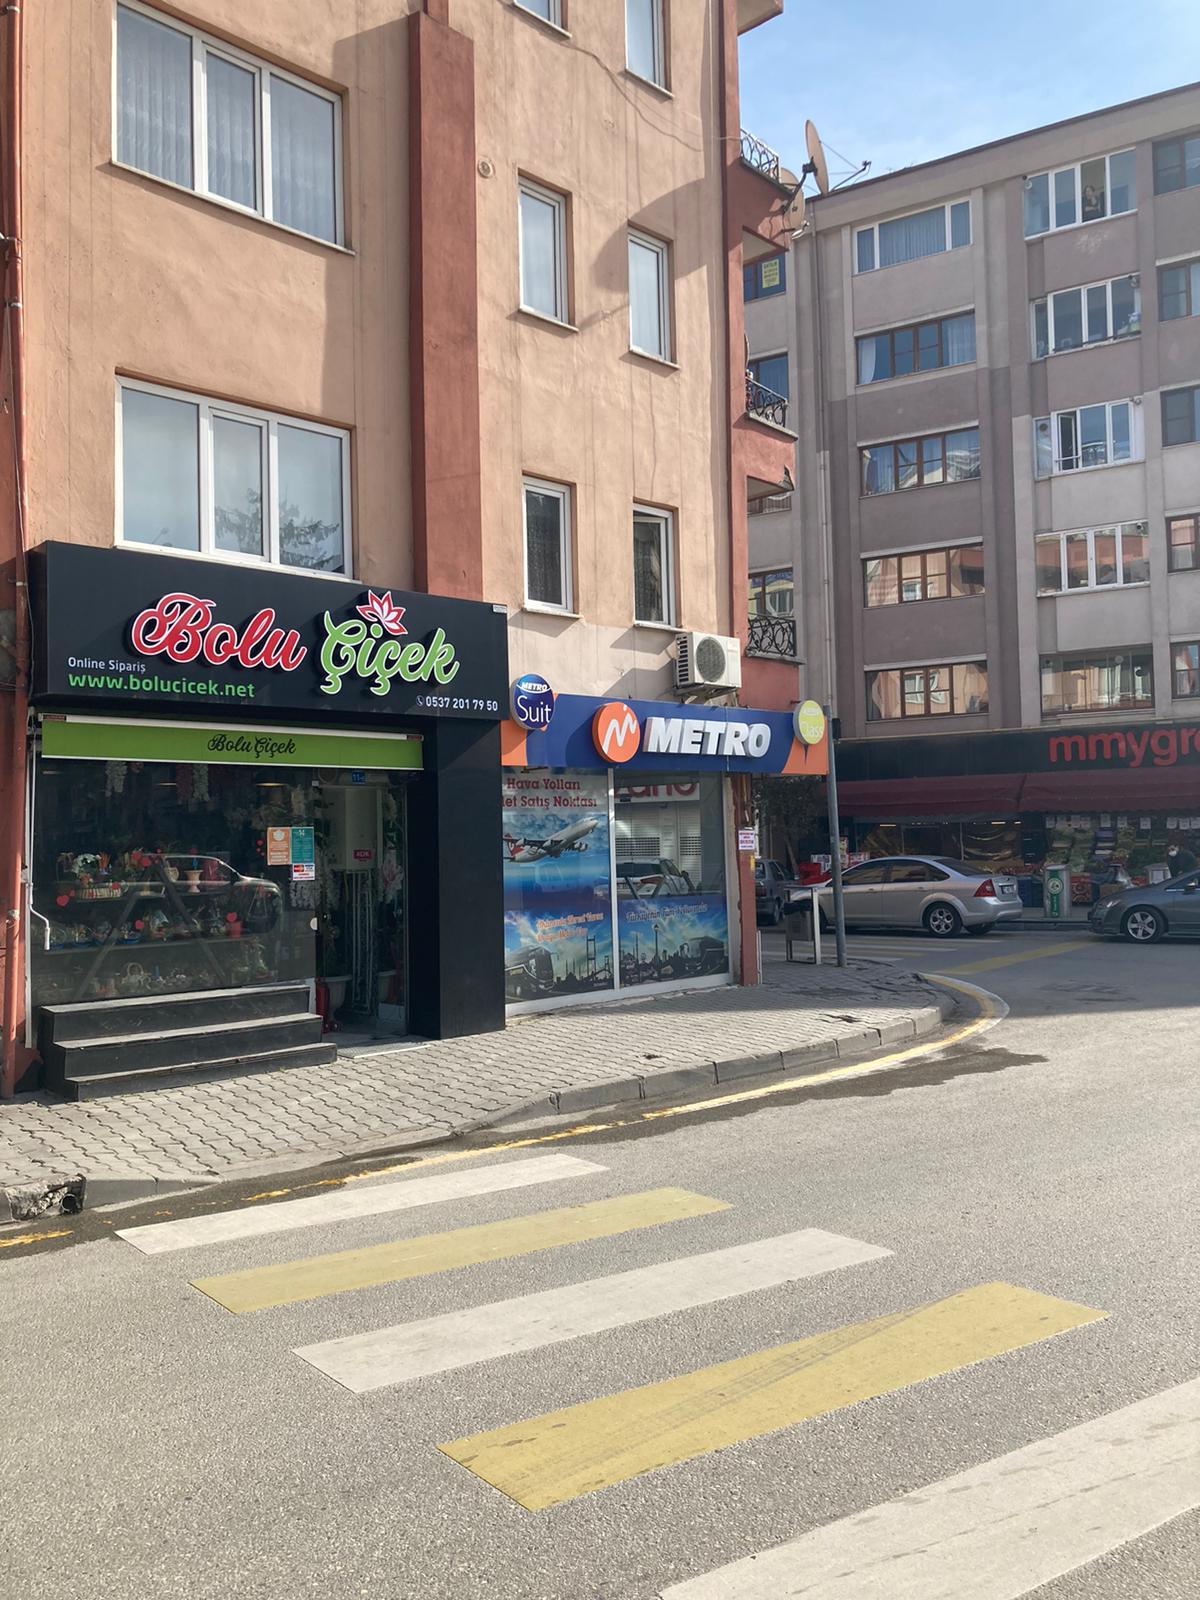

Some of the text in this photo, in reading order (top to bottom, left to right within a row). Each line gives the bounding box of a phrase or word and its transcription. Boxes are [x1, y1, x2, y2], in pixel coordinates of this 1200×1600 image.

[131, 592, 460, 696] Bolu Çiçek
[67, 656, 147, 675] Online Sipariş
[68, 673, 256, 699] www.bolucicek.net
[520, 681, 549, 692] METRO
[425, 696, 499, 712] 0537 201 79 50
[516, 695, 552, 724] Suit
[207, 733, 297, 759] Bolu Çiçek
[644, 716, 772, 758] METRO
[1049, 726, 1200, 768] mmygr
[506, 777, 540, 790] Hava
[520, 795, 550, 811] Satış
[552, 795, 598, 808] Noktası
